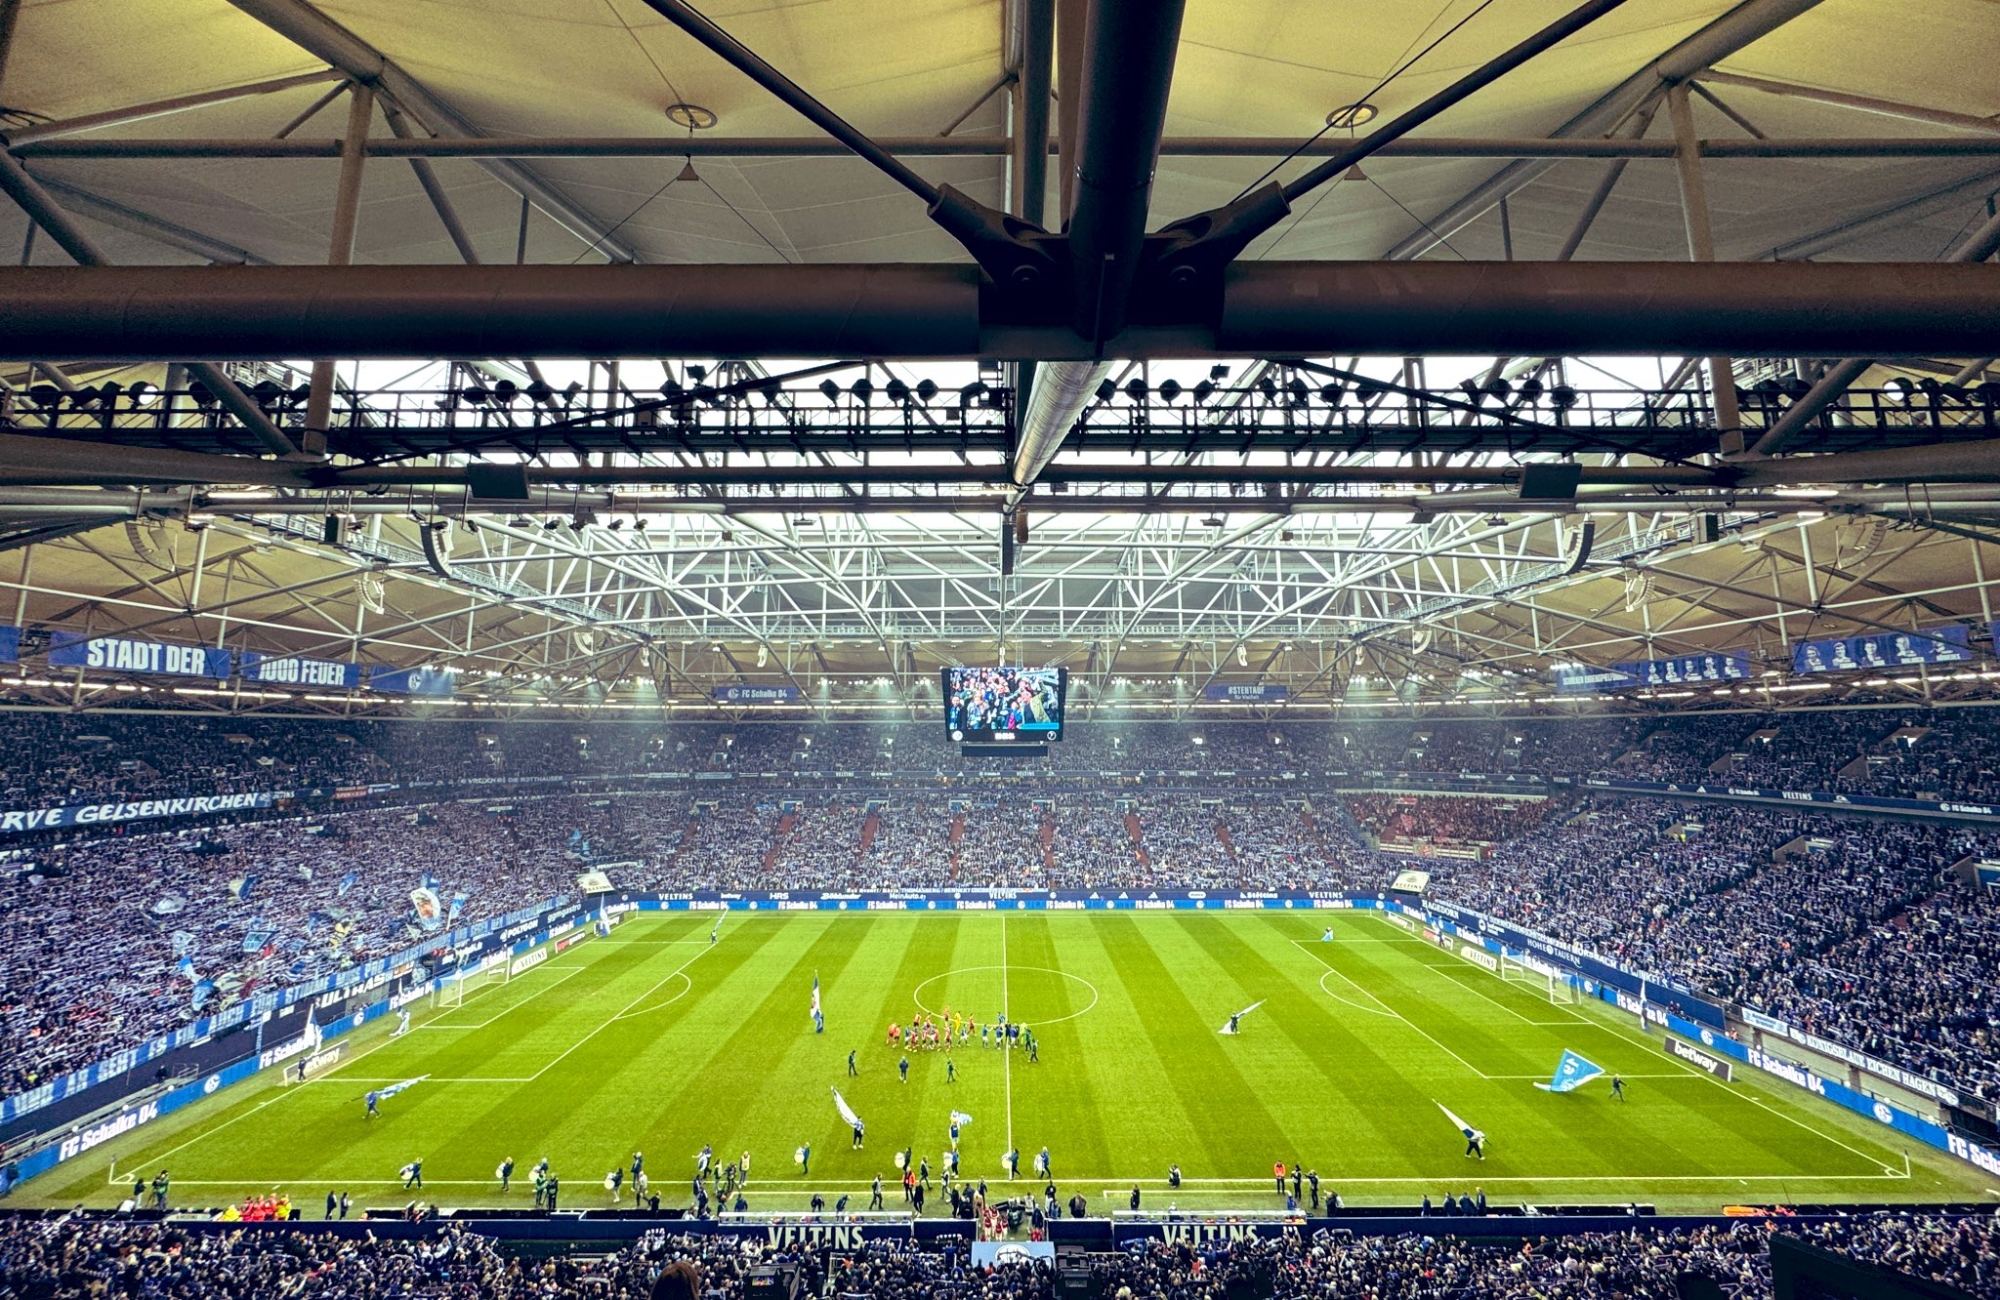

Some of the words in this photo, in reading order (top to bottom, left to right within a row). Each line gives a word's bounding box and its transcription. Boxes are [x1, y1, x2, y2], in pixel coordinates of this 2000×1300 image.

[87, 638, 162, 671] STADT
[166, 647, 206, 675] DER
[259, 656, 299, 682] 1000
[301, 660, 345, 686] FEUER
[742, 689, 750, 698] FC
[751, 688, 777, 698] Schalke
[75, 793, 258, 824] GELSENKIRCHEN
[1782, 791, 1812, 801] VELTINS
[1422, 899, 1459, 919] HAGEDORN
[508, 919, 539, 938] POLYGON
[520, 950, 546, 968] VELTINS
[1470, 950, 1494, 968] VELTINS
[1527, 938, 1546, 953] HOHE
[1554, 949, 1581, 967] TAUERN
[319, 973, 386, 1007] ULTRAS
[147, 1034, 167, 1061] ES
[259, 1050, 273, 1070] FC
[1674, 1041, 1718, 1074] betway
[1748, 1048, 1762, 1068] FC
[1762, 1054, 1807, 1088] Schalke
[1807, 1073, 1825, 1095] 04
[1866, 1057, 1901, 1083] EICHEN
[1902, 1071, 1937, 1098] HAGEN
[59, 1134, 80, 1162] FC
[80, 1112, 138, 1152] Schalke
[138, 1100, 159, 1125] 04
[1946, 1132, 1969, 1159] FC
[768, 1226, 863, 1251] VELTINS
[1162, 1225, 1258, 1248] VELTINS
